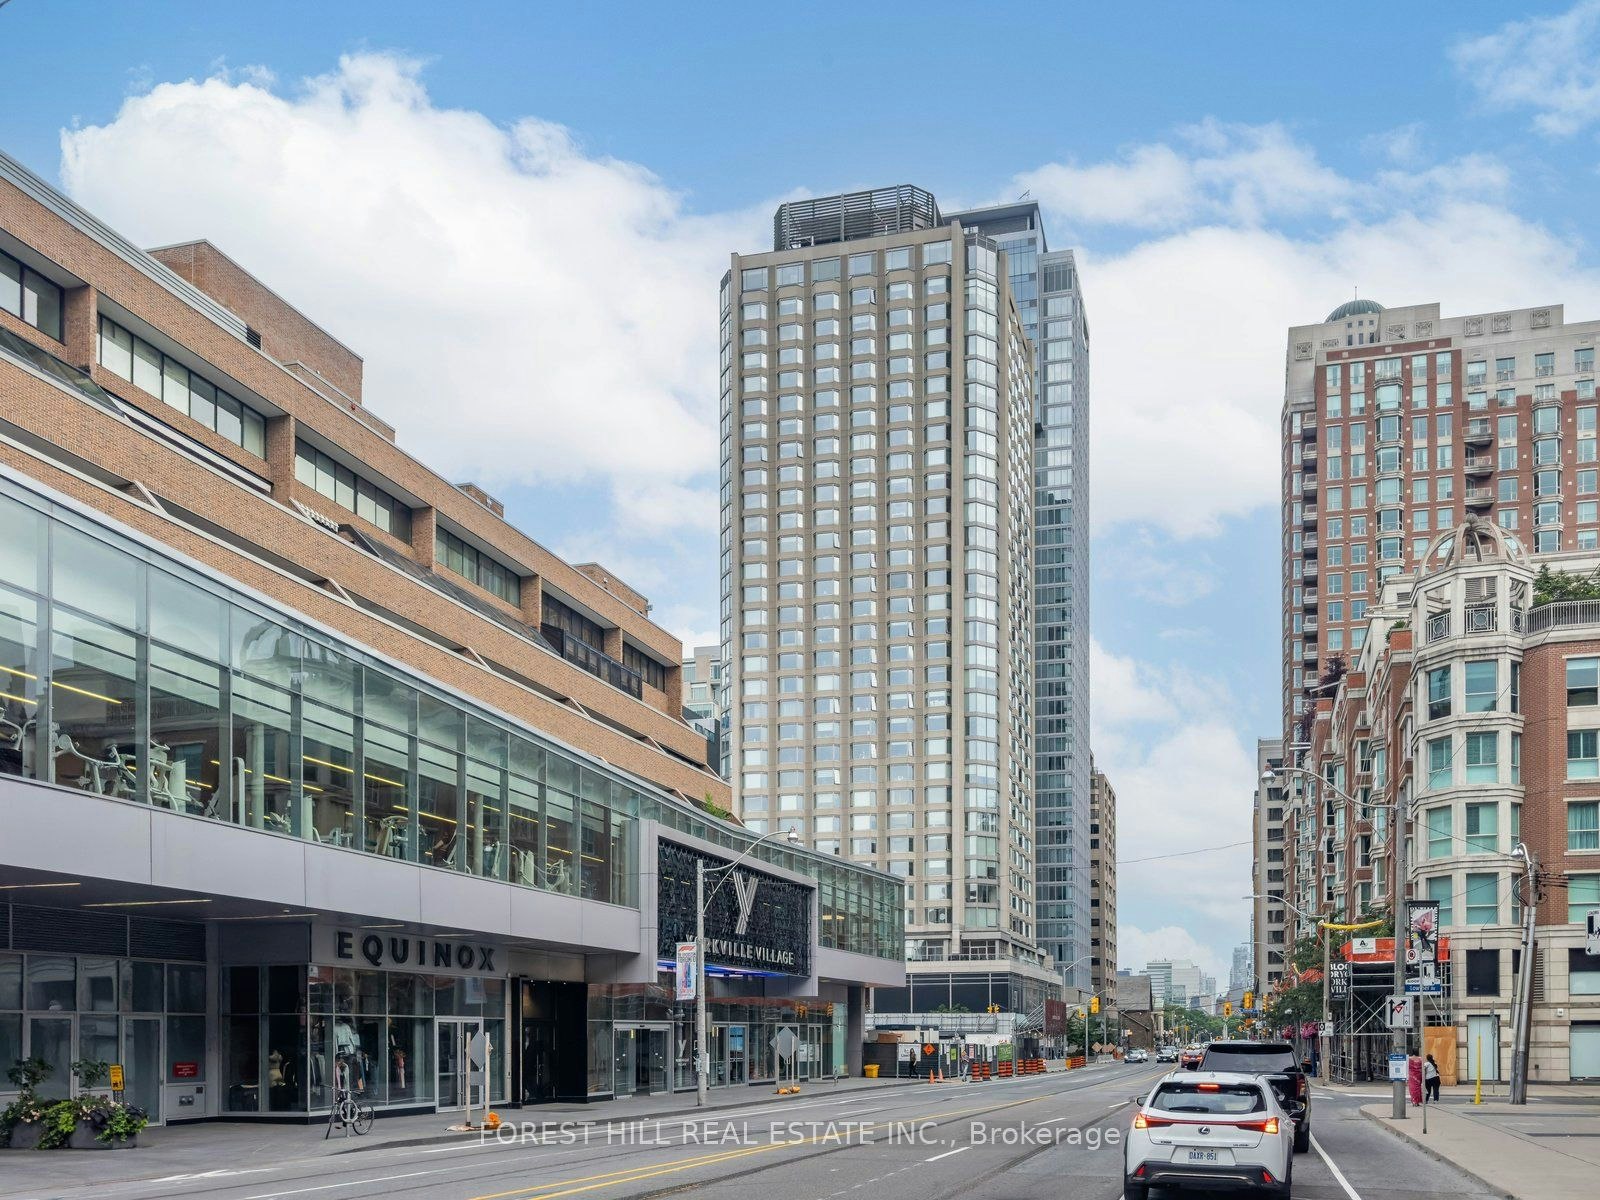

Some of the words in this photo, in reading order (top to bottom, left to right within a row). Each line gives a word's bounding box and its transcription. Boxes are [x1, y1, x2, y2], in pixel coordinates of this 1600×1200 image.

[337, 931, 495, 971] EQUINOX
[685, 933, 753, 959] YRKVILLE
[755, 946, 795, 965] VILLAGE
